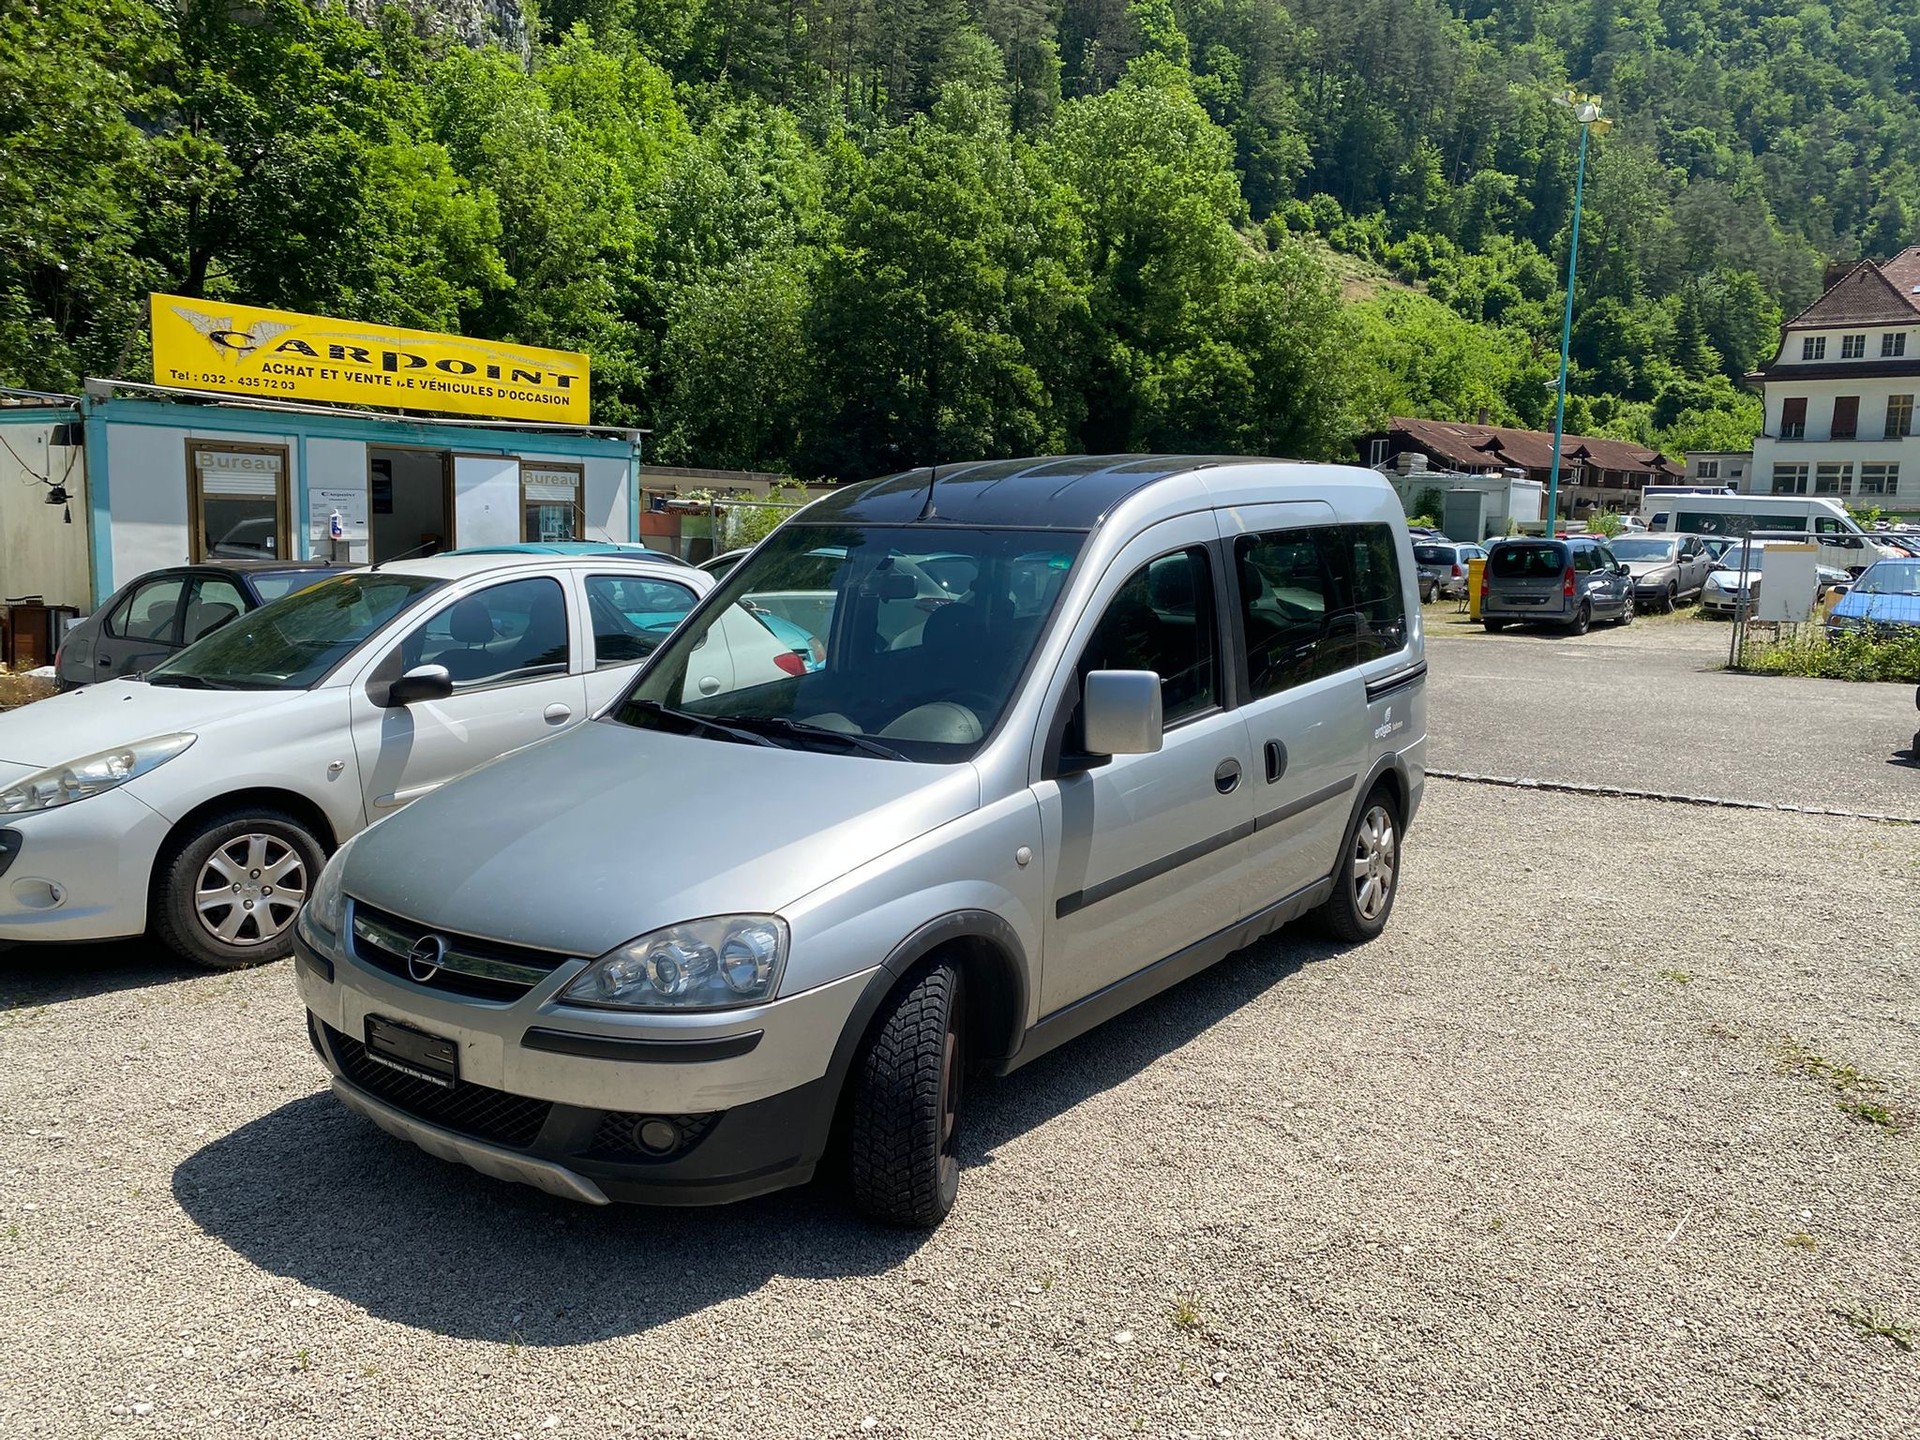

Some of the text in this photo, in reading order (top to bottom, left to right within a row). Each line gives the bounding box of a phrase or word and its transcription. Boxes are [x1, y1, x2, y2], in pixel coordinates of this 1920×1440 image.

[169, 369, 190, 381] Tel
[201, 373, 226, 385] 032
[237, 376, 260, 388] 435
[263, 378, 278, 389] 72
[280, 380, 296, 391] 03
[261, 362, 315, 378] ACHAT
[320, 368, 339, 380] ET
[344, 371, 392, 387] VENTE
[419, 377, 494, 397] VÉHICULES
[497, 388, 570, 406] D'OCCASION
[200, 453, 280, 470] Bureau
[523, 471, 577, 485] Bureau
